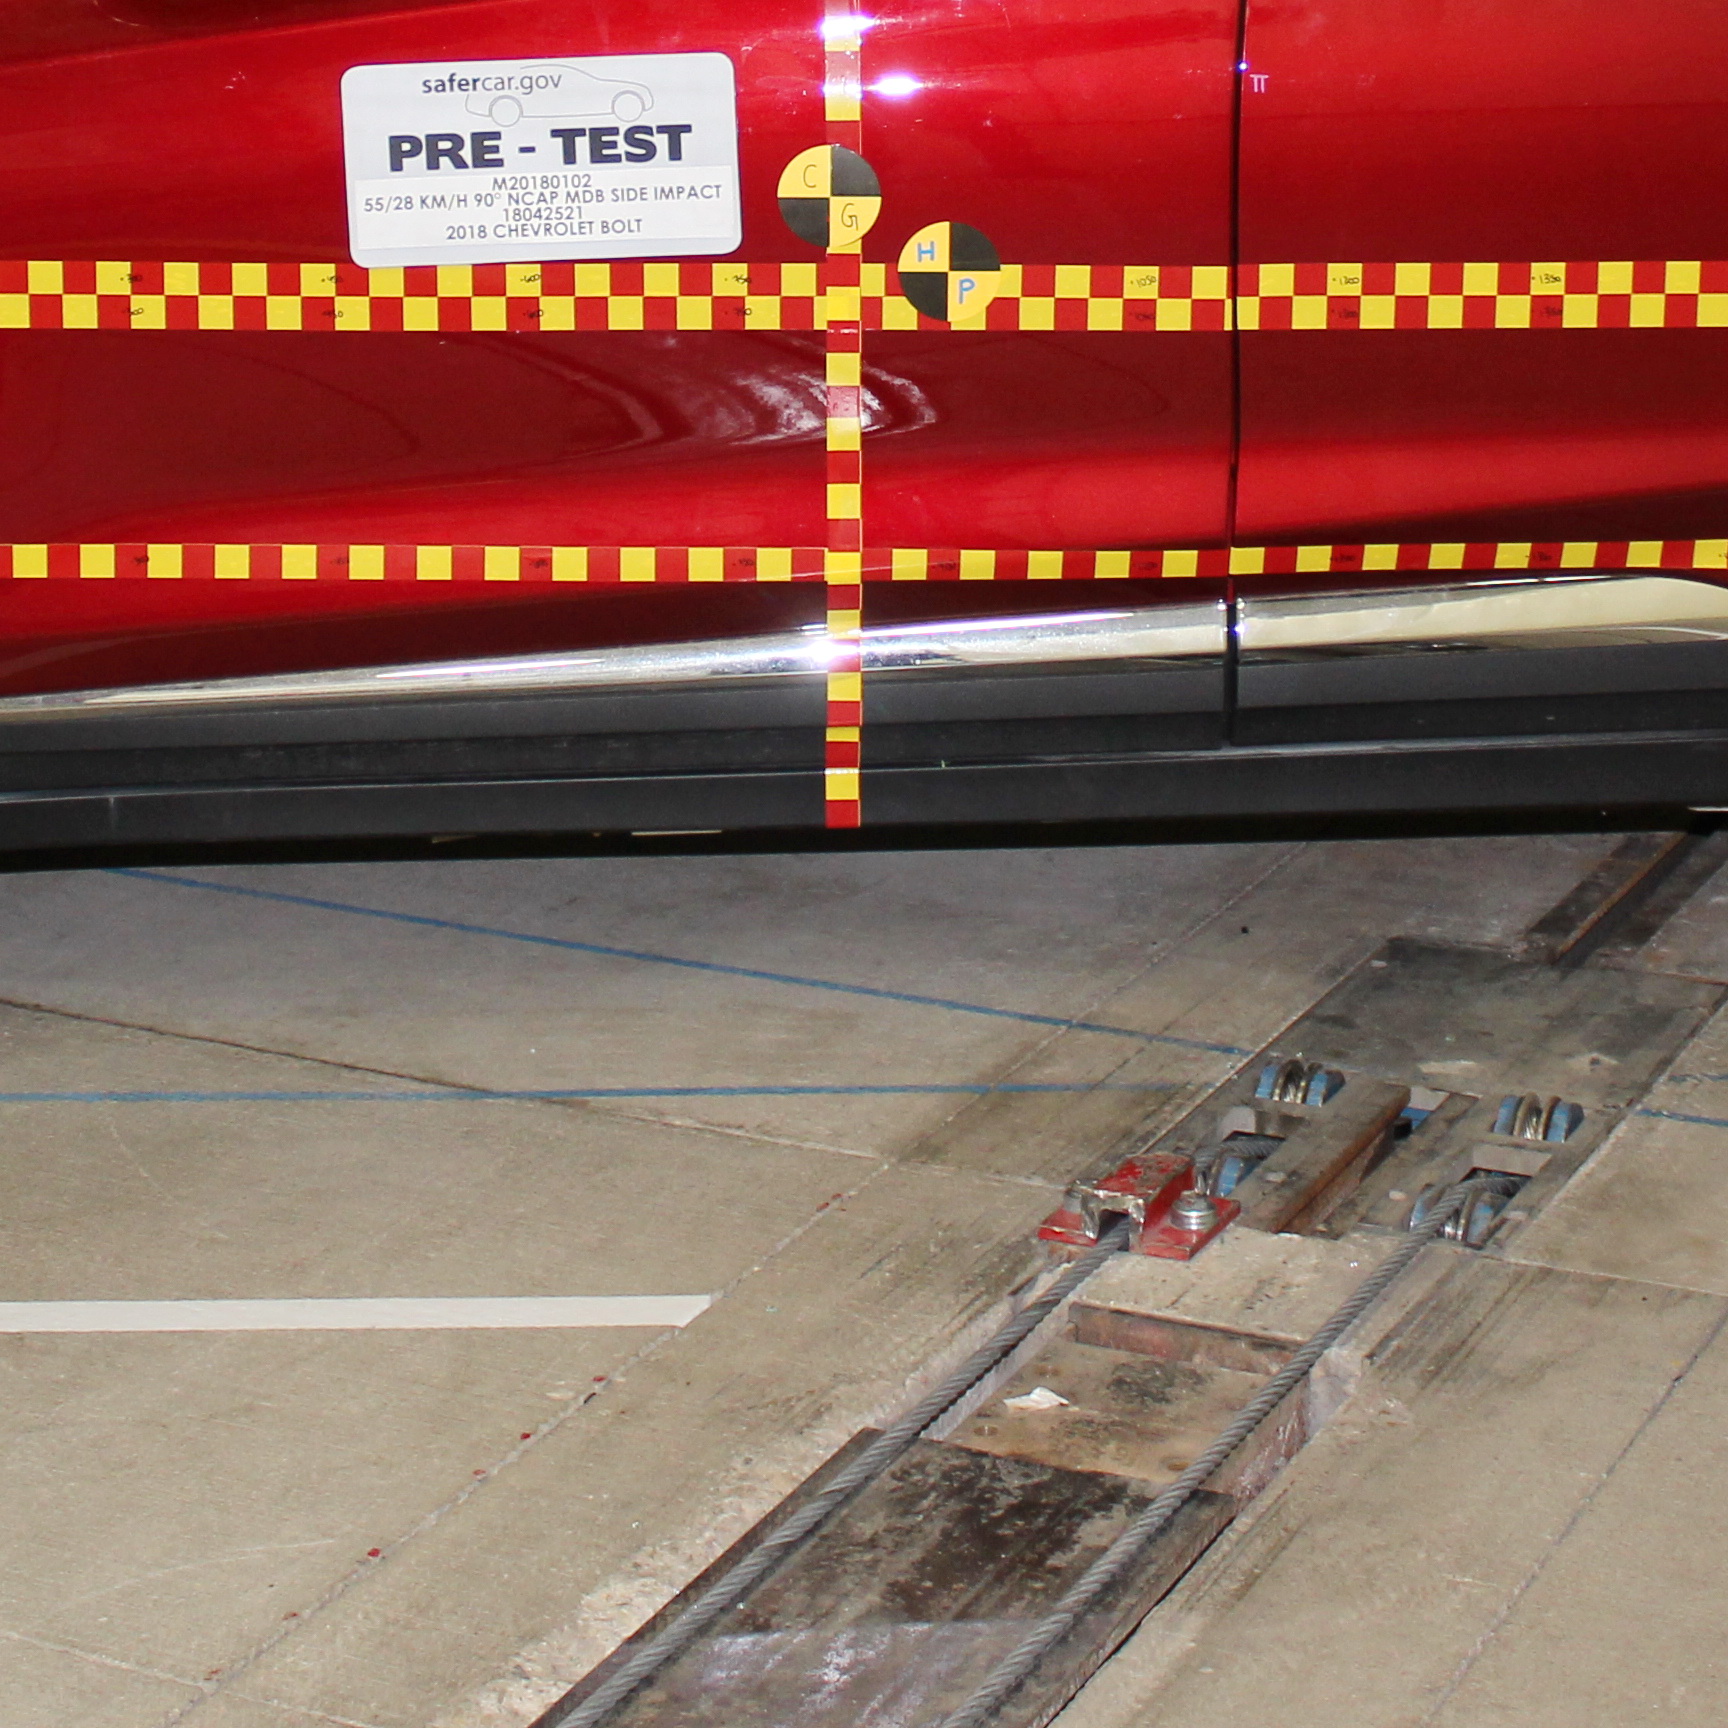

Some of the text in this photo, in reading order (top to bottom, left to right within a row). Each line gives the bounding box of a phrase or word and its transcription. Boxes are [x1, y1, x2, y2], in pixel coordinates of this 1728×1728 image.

[422, 72, 563, 95] safercar.gov
[388, 131, 505, 172] PRE
[550, 124, 693, 165] TEST
[491, 174, 593, 191] M20180102
[363, 195, 414, 213] 55/28
[419, 193, 469, 211] KM/H
[507, 190, 560, 207] NCAP
[564, 188, 606, 204] MDB
[610, 186, 650, 203] SIDE
[653, 183, 723, 201] IMPACT
[503, 205, 584, 222] 18042521
[445, 219, 643, 240] 2018 CHEVROLET BOLT
[916, 240, 936, 263] H
[1136, 275, 1158, 288] 1050
[1539, 273, 1562, 285] 1350
[957, 278, 977, 305] P
